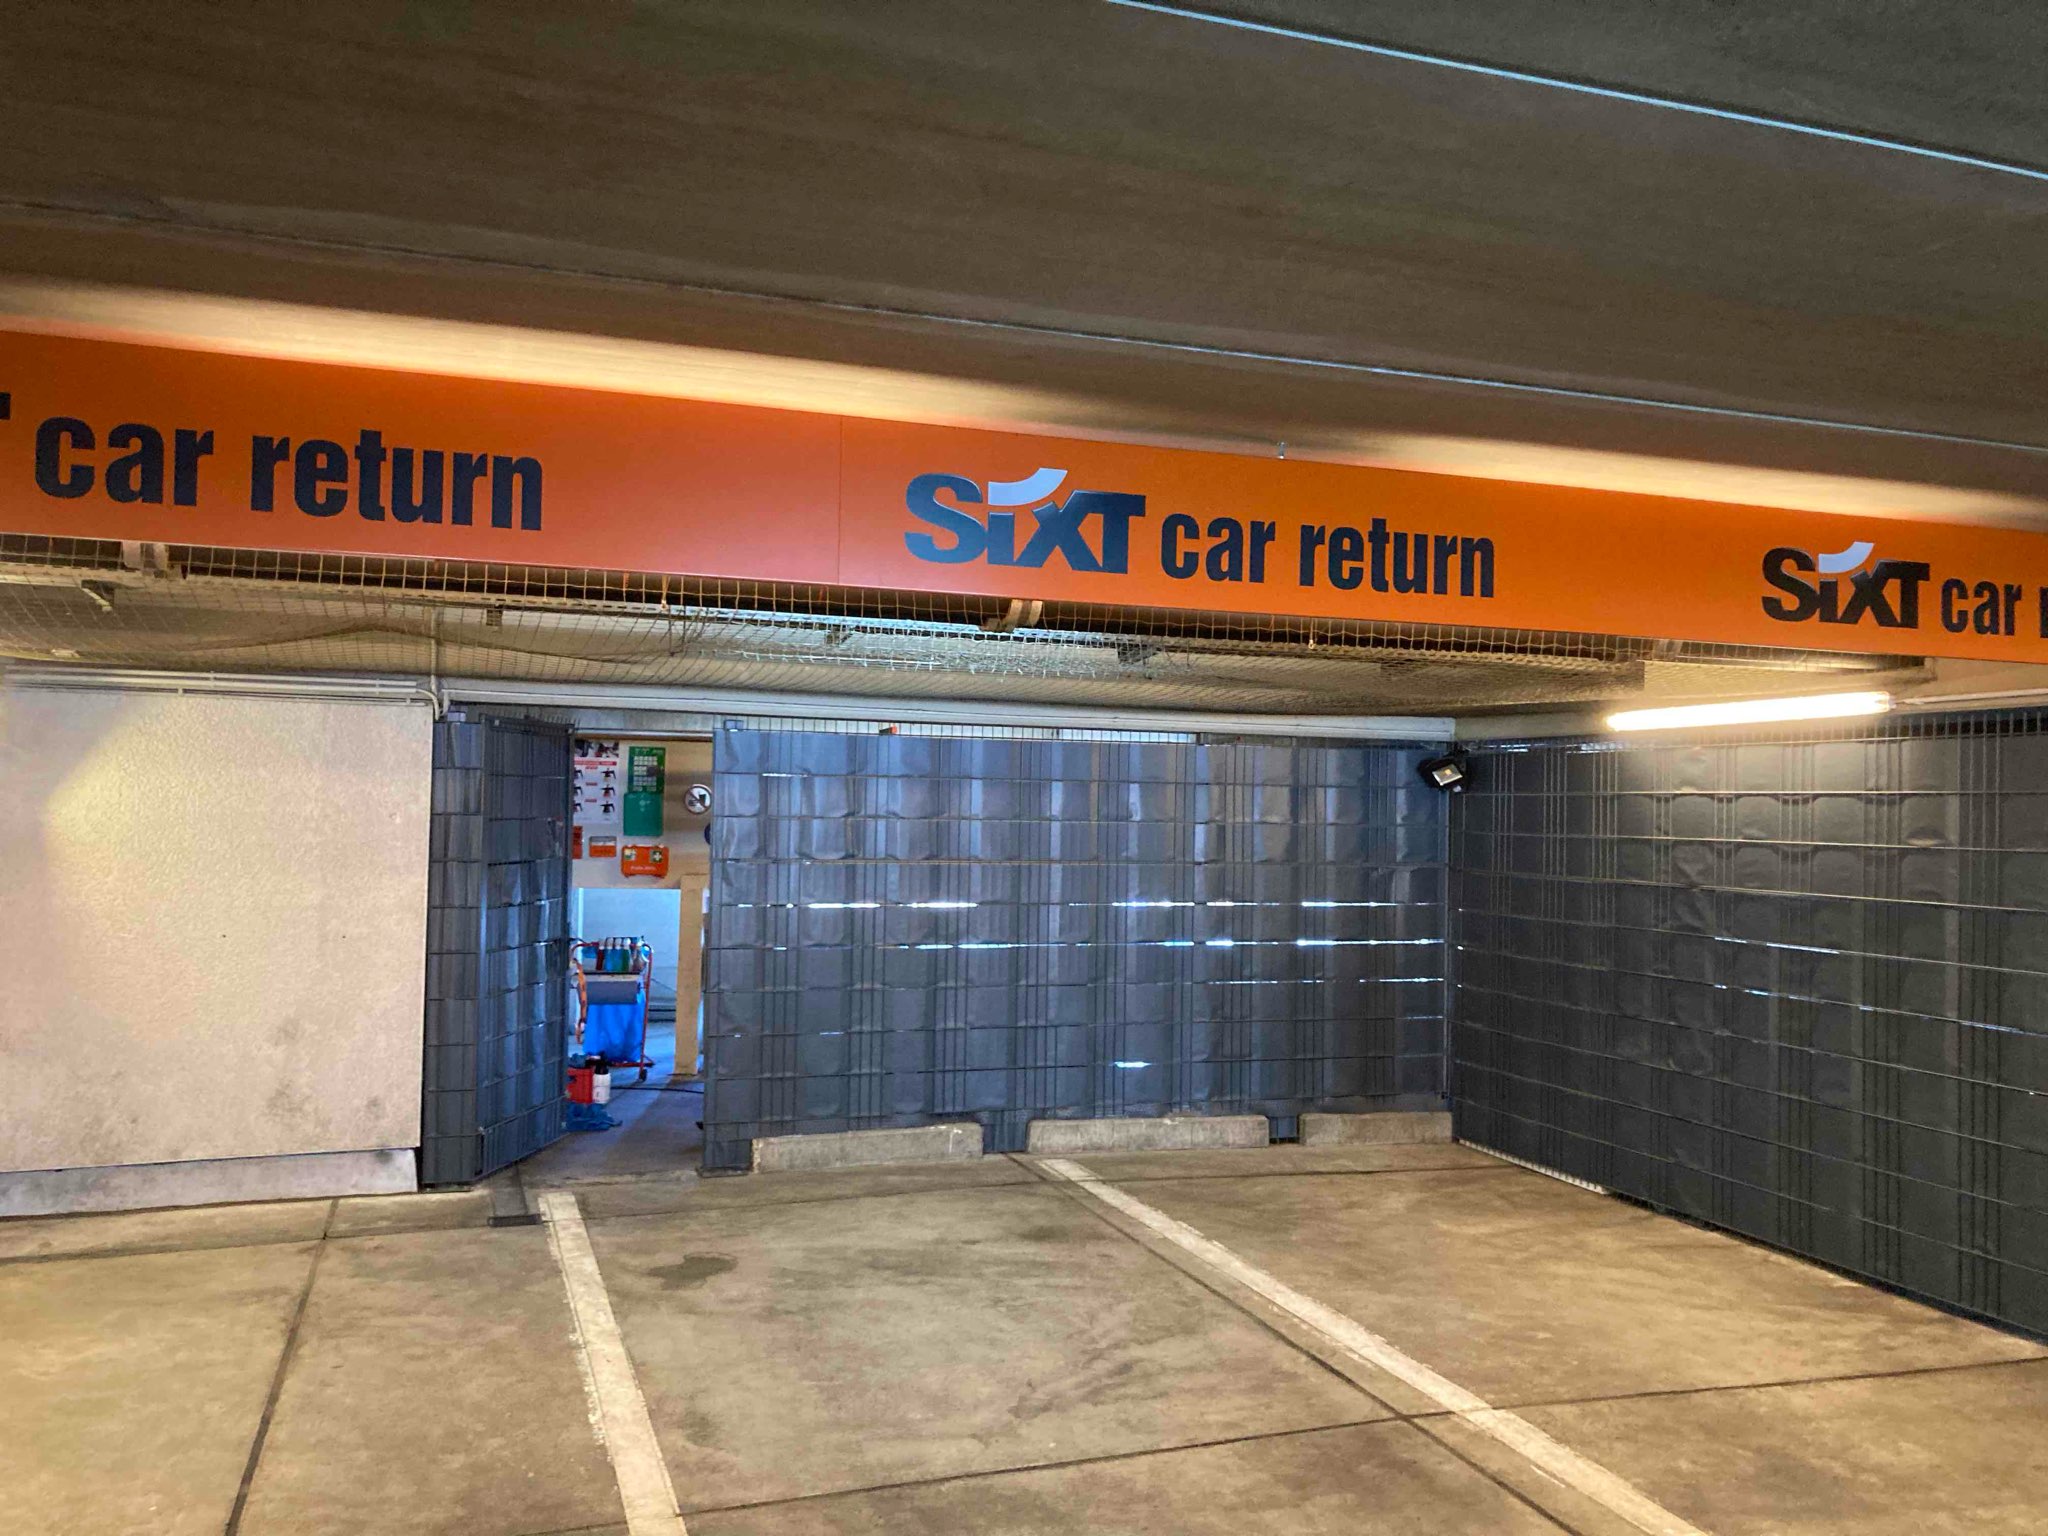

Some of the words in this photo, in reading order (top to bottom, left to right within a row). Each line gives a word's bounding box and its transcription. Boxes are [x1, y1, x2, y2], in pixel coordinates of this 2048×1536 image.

[35, 416, 214, 507] car
[250, 429, 543, 531] return
[1161, 513, 1276, 583] car
[1300, 517, 1495, 598] return
[1941, 578, 2023, 636] car
